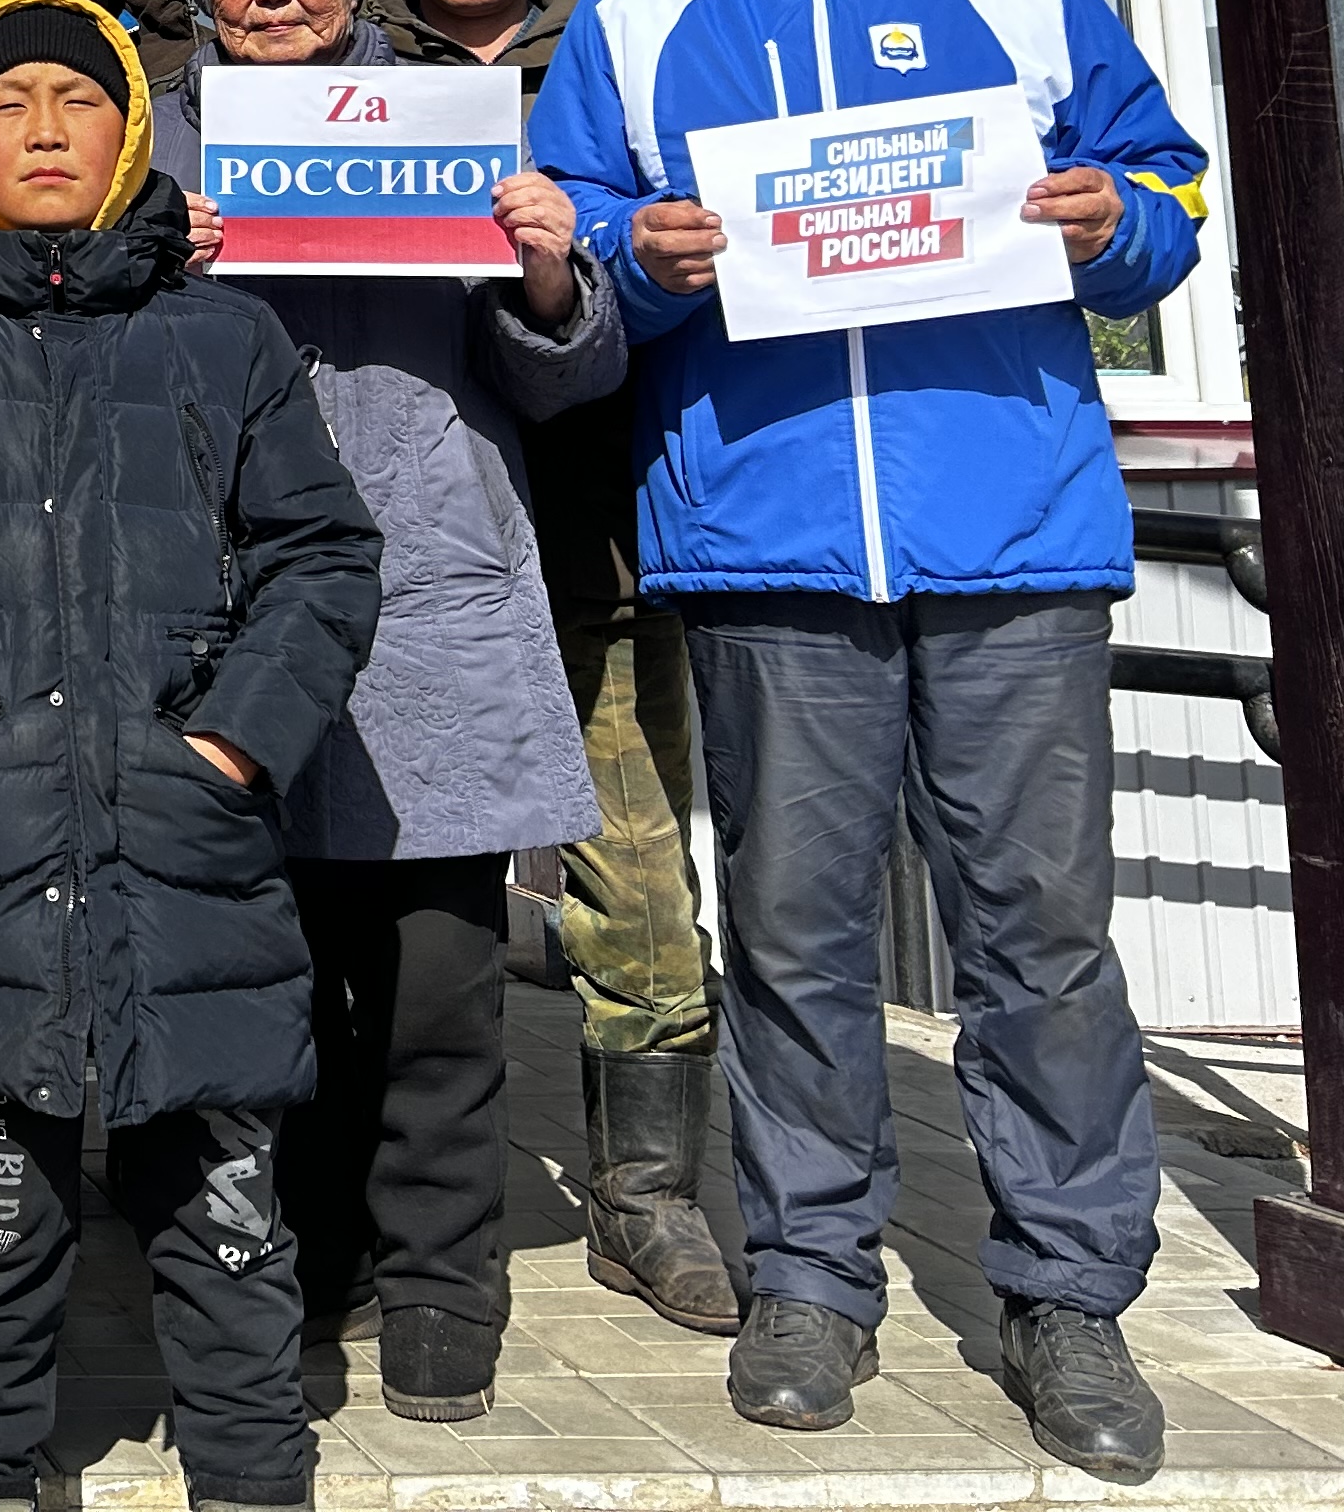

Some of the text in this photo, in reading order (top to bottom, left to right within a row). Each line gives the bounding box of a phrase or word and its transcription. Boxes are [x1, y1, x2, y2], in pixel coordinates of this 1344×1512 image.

[325, 85, 390, 122] Za
[826, 124, 949, 166] СИЛЬНЫЙ
[216, 157, 502, 196] РОССИЮ!
[773, 154, 946, 206] ПРЕЗИДЕНТ
[798, 200, 911, 238] СИЛЬНАЯ
[821, 225, 940, 268] РОССИЯ
